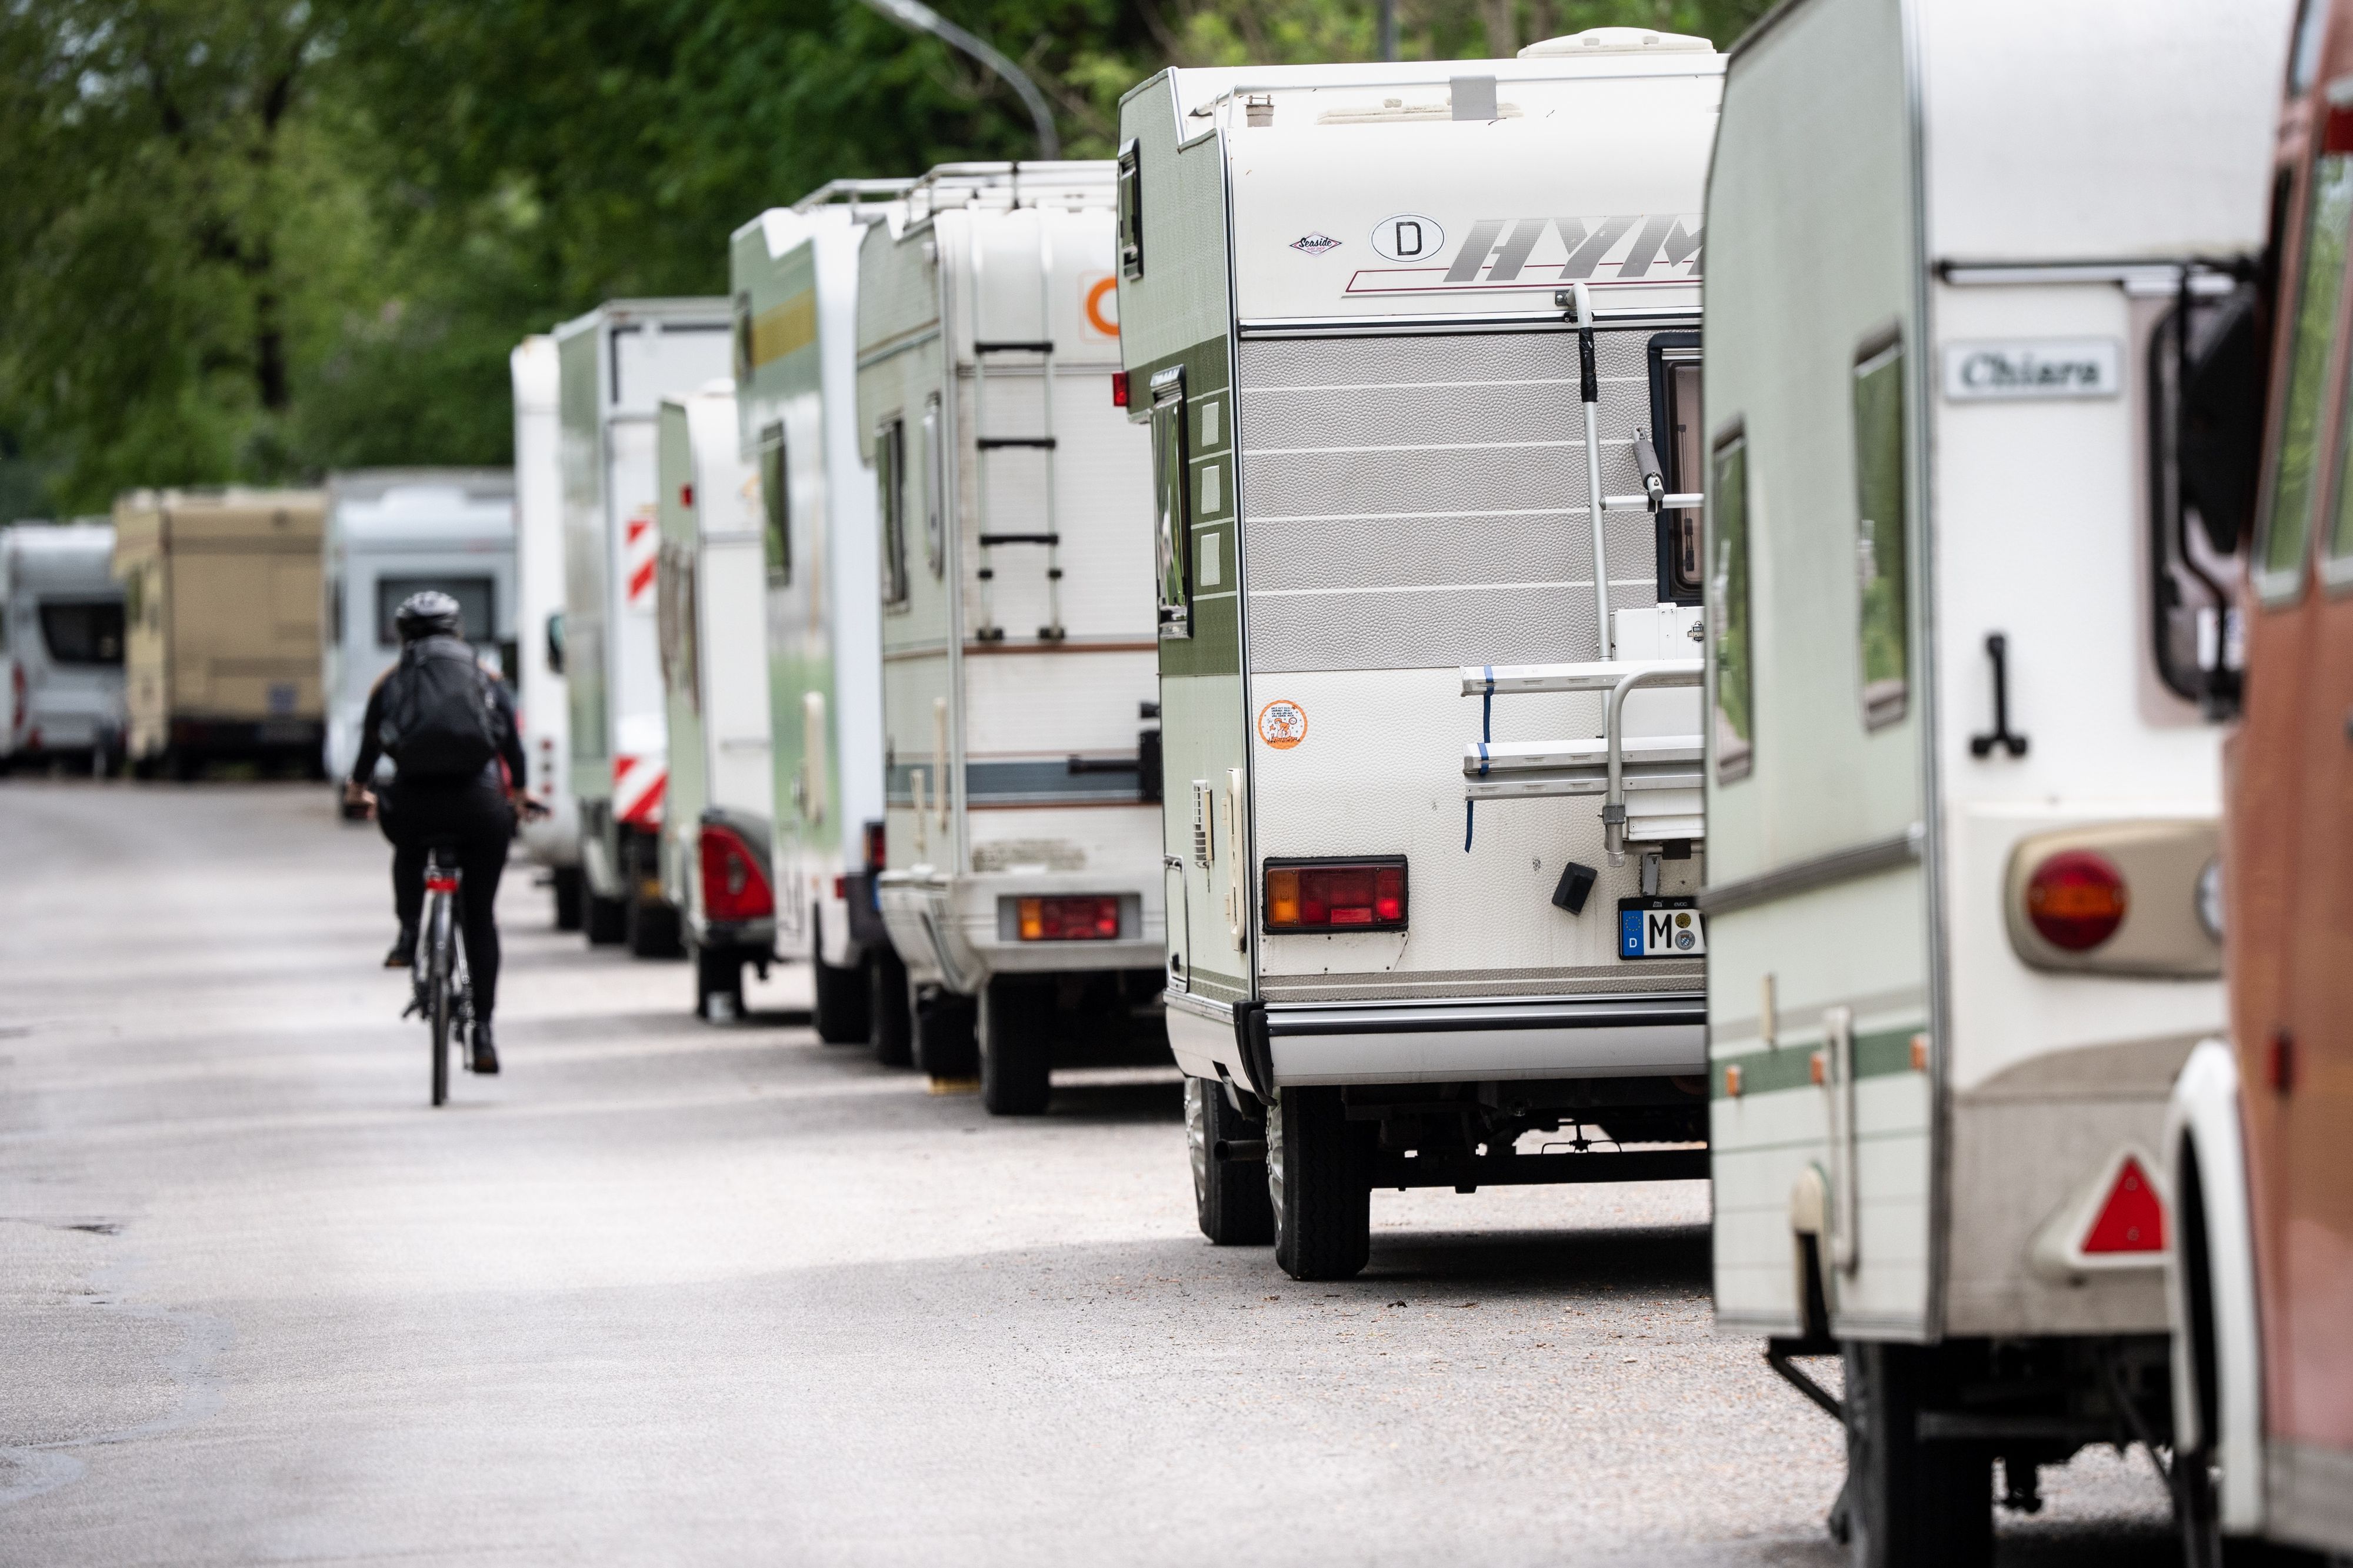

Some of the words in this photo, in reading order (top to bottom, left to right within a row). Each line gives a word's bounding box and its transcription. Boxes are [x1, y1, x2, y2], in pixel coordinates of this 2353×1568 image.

[1299, 237, 1332, 248] Seaside
[1396, 221, 1422, 256] D
[1961, 352, 2101, 388] Chiara
[1629, 938, 1637, 948] D
[1649, 913, 1672, 949] M
